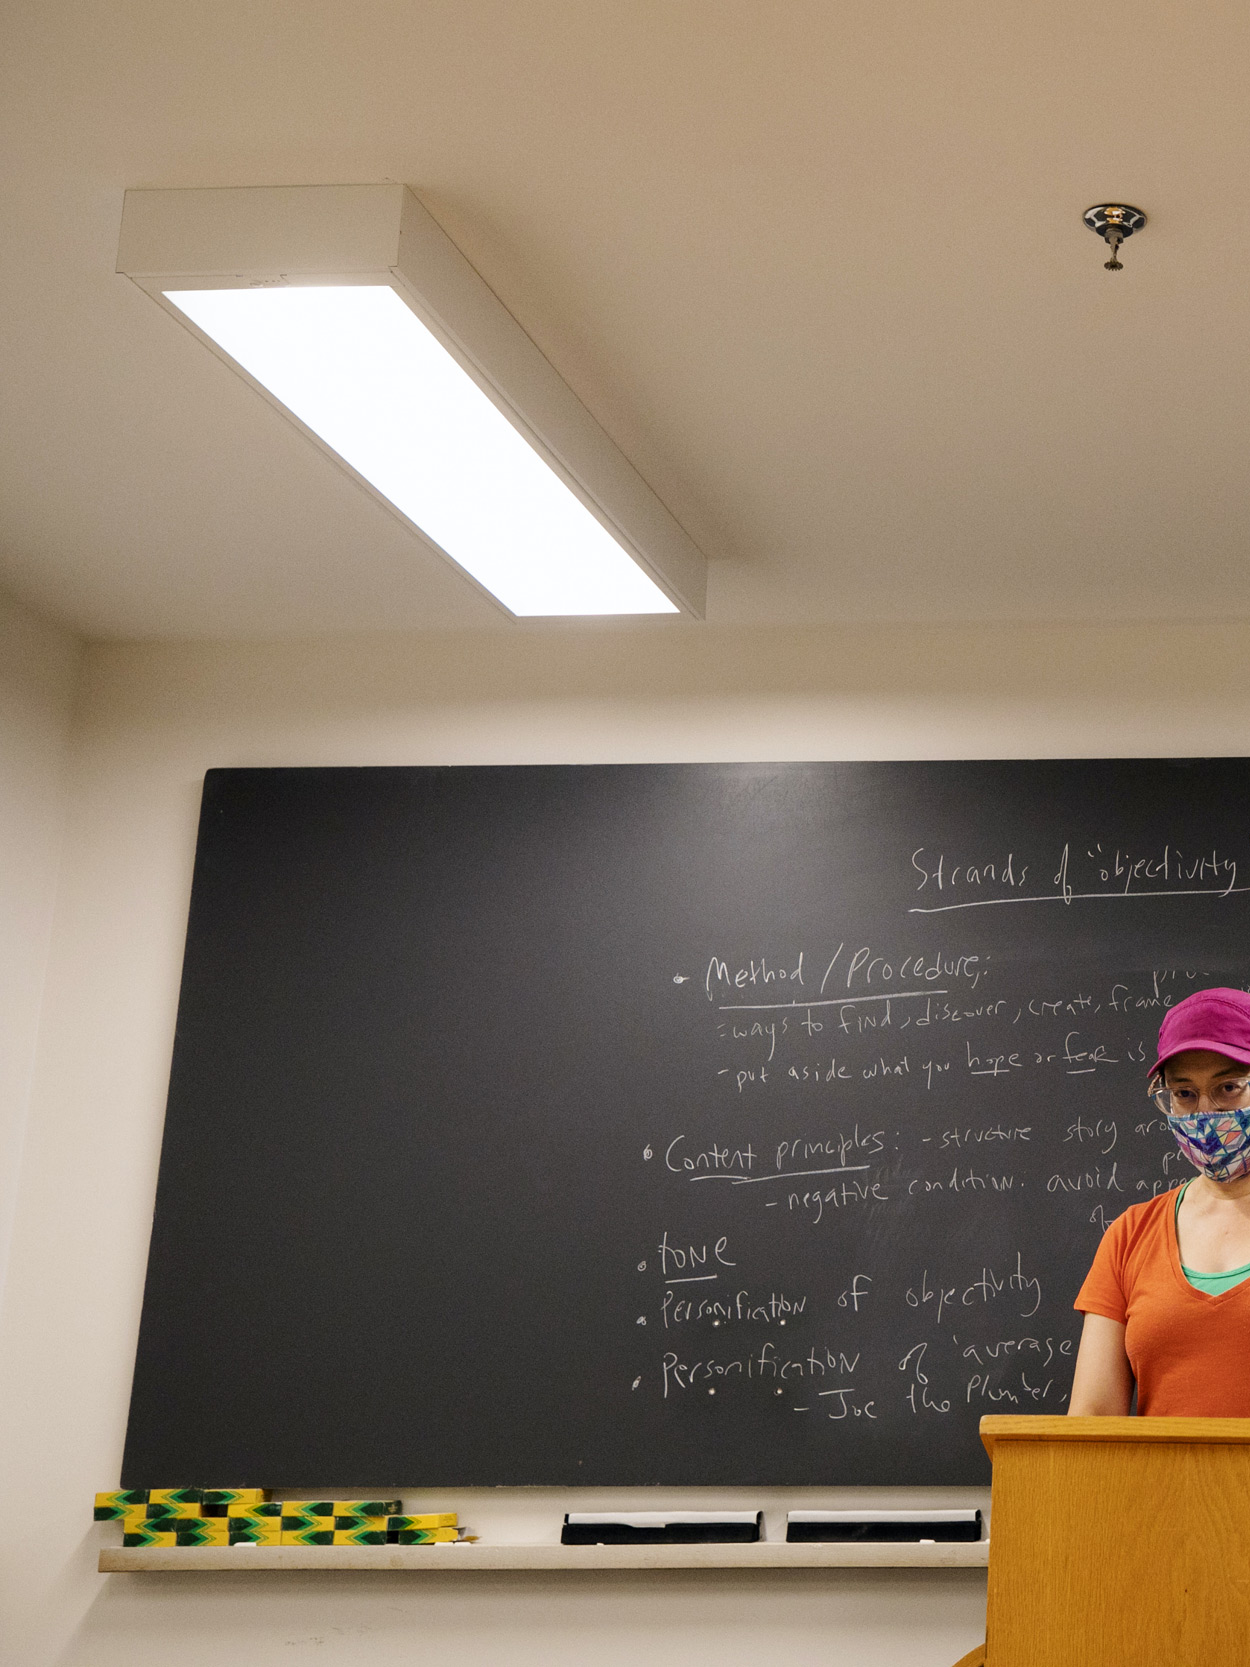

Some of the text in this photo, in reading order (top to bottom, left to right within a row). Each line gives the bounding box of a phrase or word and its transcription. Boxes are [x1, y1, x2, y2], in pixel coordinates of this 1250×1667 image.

[911, 847, 1029, 890] Strands
[705, 951, 804, 997] Method
[801, 1008, 824, 1037] to
[1108, 983, 1174, 1013] frame
[787, 1058, 852, 1082] aside
[862, 1055, 910, 1080] what
[921, 1059, 950, 1090] you
[966, 1040, 1023, 1077] hope
[1126, 1036, 1146, 1062] is
[665, 1134, 758, 1172] Content
[1062, 1115, 1118, 1155] story
[1046, 1161, 1126, 1193] avoid
[660, 1251, 1042, 1329] Personification of objectivity
[662, 1341, 861, 1399] Personification
[906, 1382, 951, 1413] the
